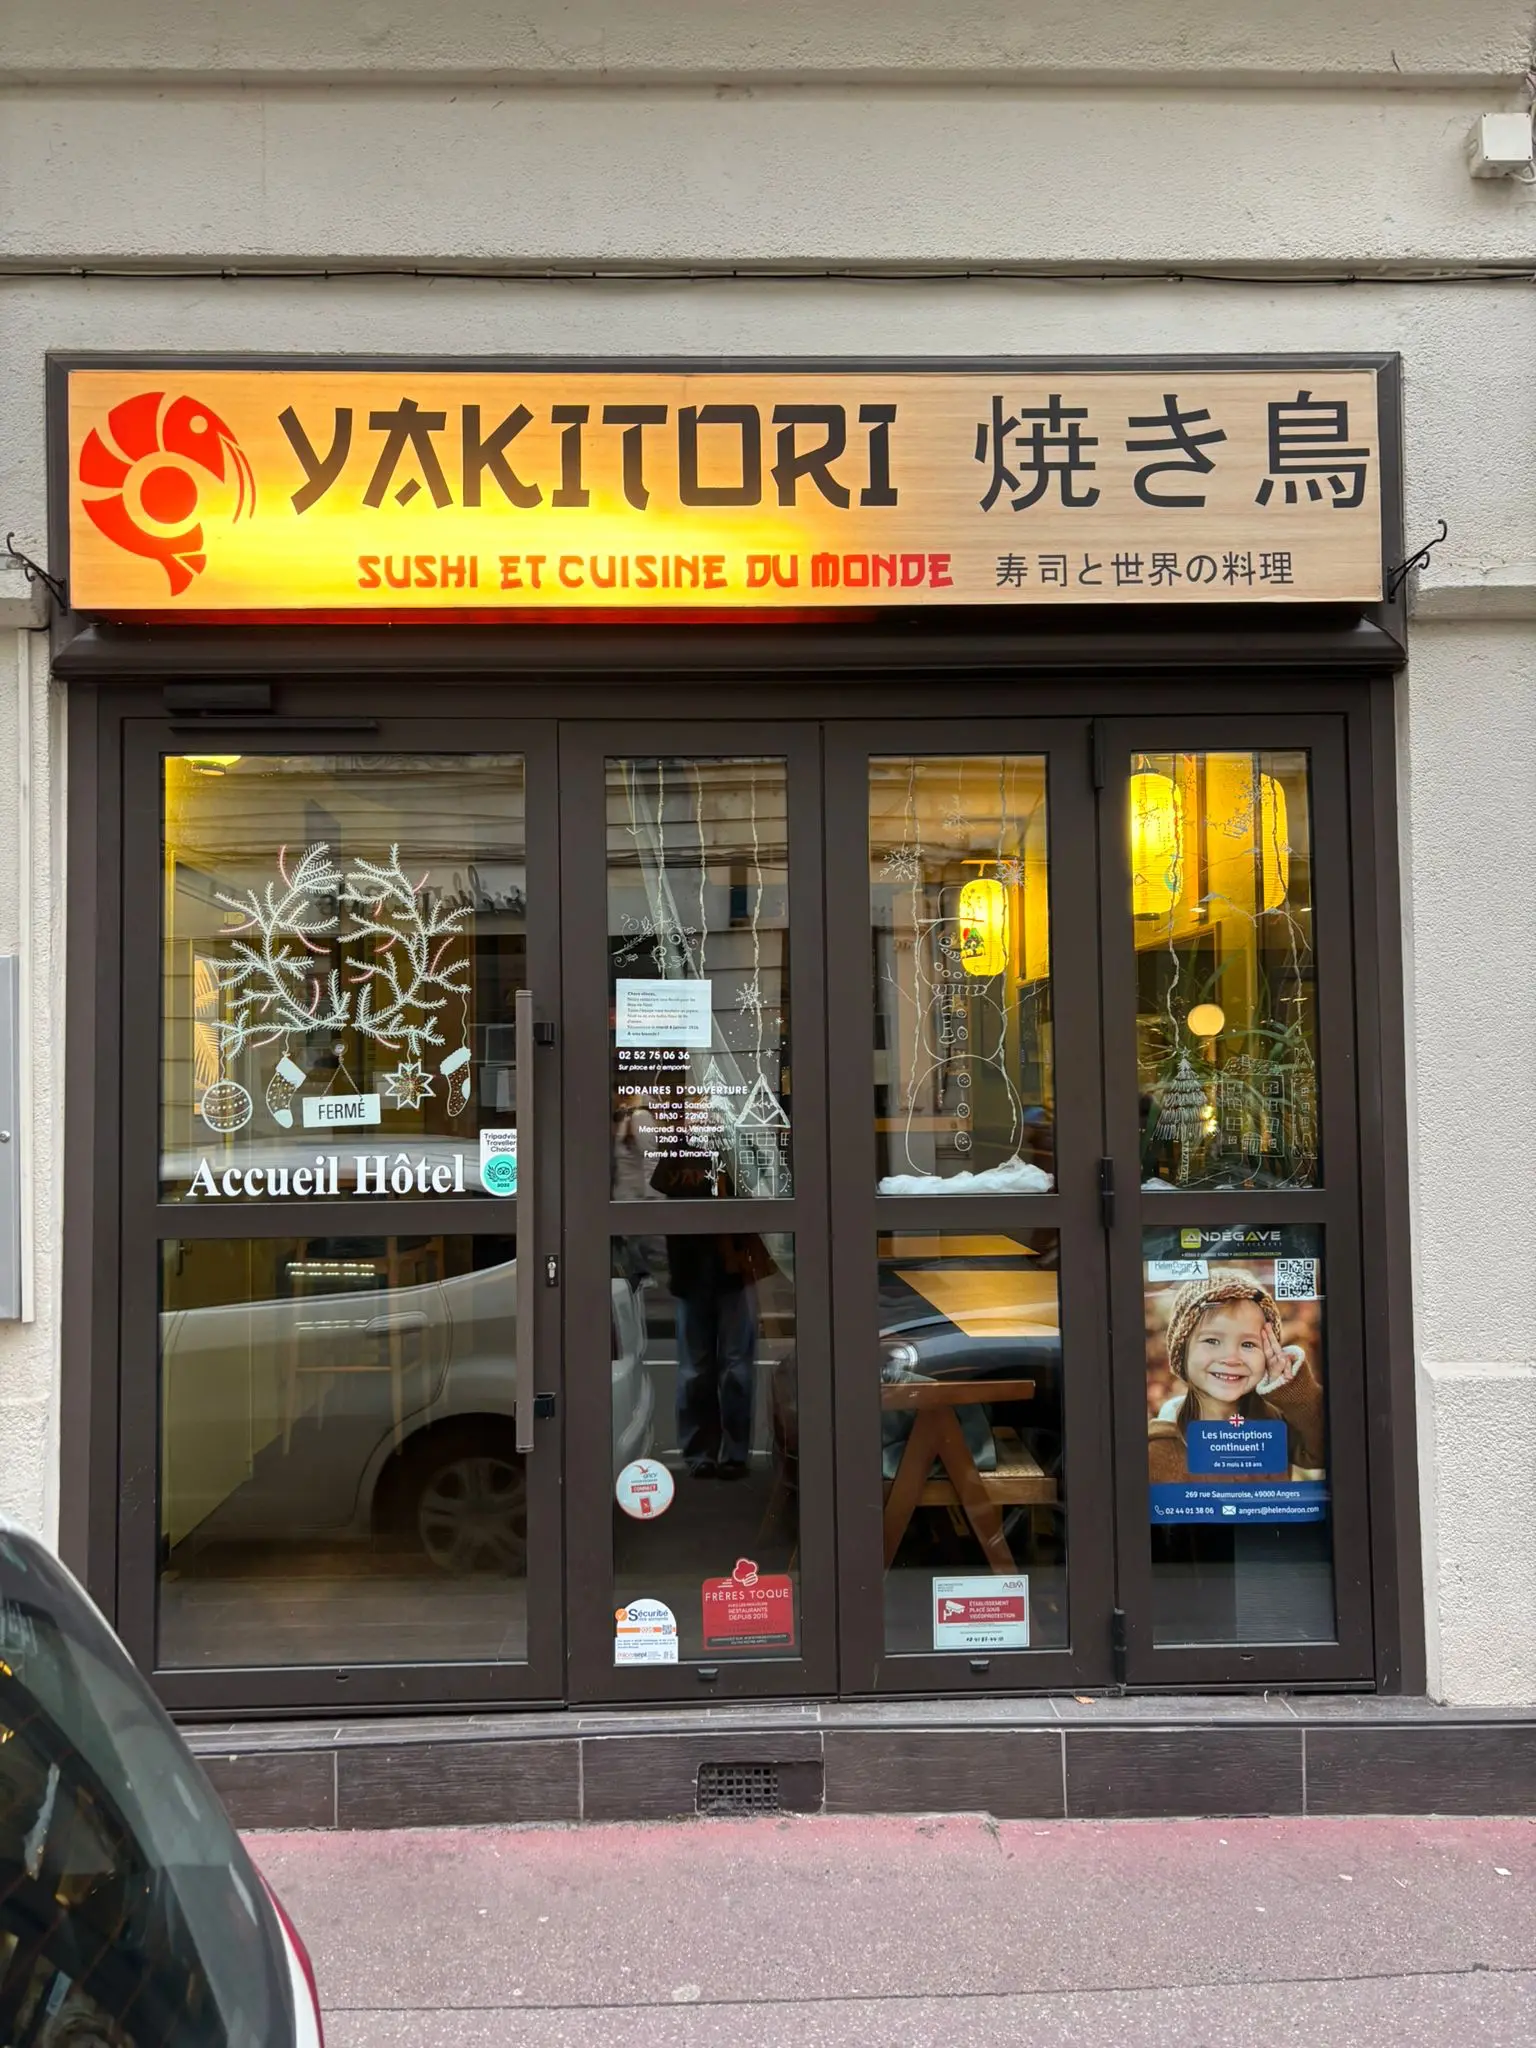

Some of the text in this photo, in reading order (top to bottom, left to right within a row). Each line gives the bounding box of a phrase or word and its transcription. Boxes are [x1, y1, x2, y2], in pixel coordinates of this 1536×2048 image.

[279, 397, 897, 515] YAKITORI
[974, 390, 1370, 512] 焼き鳥
[358, 554, 952, 589] SUSHI ET CUISINE DU MONDE
[995, 551, 1294, 588] 寿司と世界の料理
[618, 1051, 690, 1060] 02 52 75 06 36
[629, 1064, 648, 1072] place
[618, 1086, 748, 1095] HORAIRES D'OUVERTURE
[317, 1100, 366, 1120] FERMÉ
[648, 1101, 670, 1110] Lundi
[655, 1112, 678, 1120] 18h30
[639, 1125, 674, 1133] Mercredi
[688, 1125, 724, 1133] Vendredi
[655, 1135, 678, 1143] 12h00
[644, 1149, 720, 1158] Fermé le Dimanche
[186, 1153, 466, 1197] Accueil Hôtel
[1202, 1430, 1272, 1441] Les inscriptions
[1210, 1442, 1259, 1451] continuent
[1212, 1491, 1254, 1499] Saumuroise,
[1254, 1490, 1276, 1498] 49000
[1276, 1490, 1300, 1499] Angers
[1238, 1505, 1320, 1516] angers@helendoron.com
[705, 1588, 789, 1601] FRÈRES TOQUE
[628, 1608, 668, 1621] Sécurité
